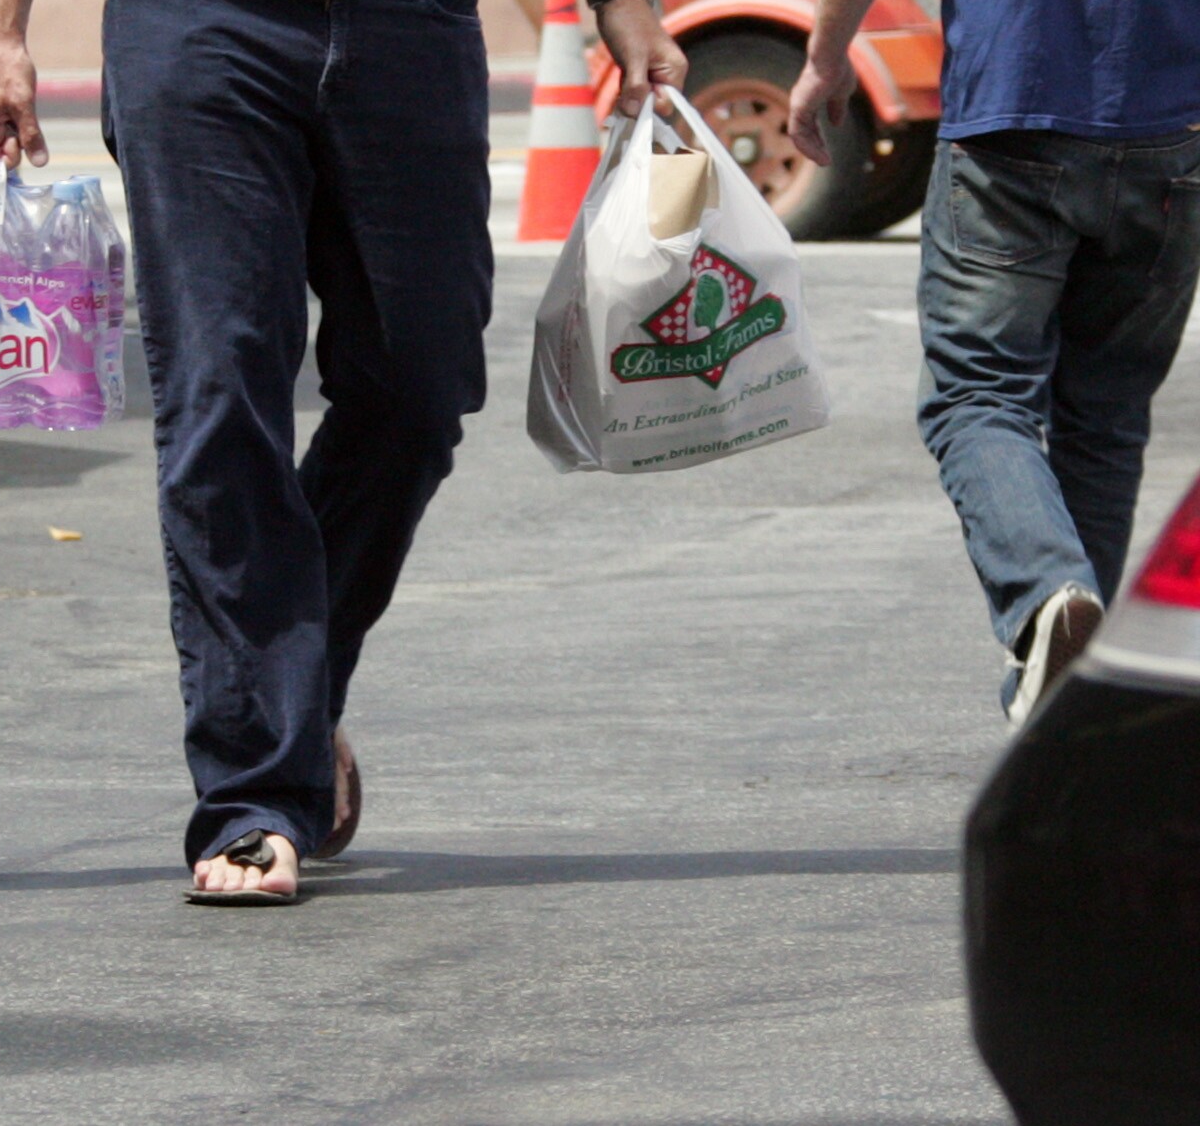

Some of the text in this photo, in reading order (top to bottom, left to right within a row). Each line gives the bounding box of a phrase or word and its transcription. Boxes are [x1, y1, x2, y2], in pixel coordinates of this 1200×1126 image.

[620, 311, 777, 375] Bristol Farms
[603, 418, 629, 433] An
[634, 395, 738, 431] Extraordinary
[632, 417, 790, 467] www.bristolfarms.com
